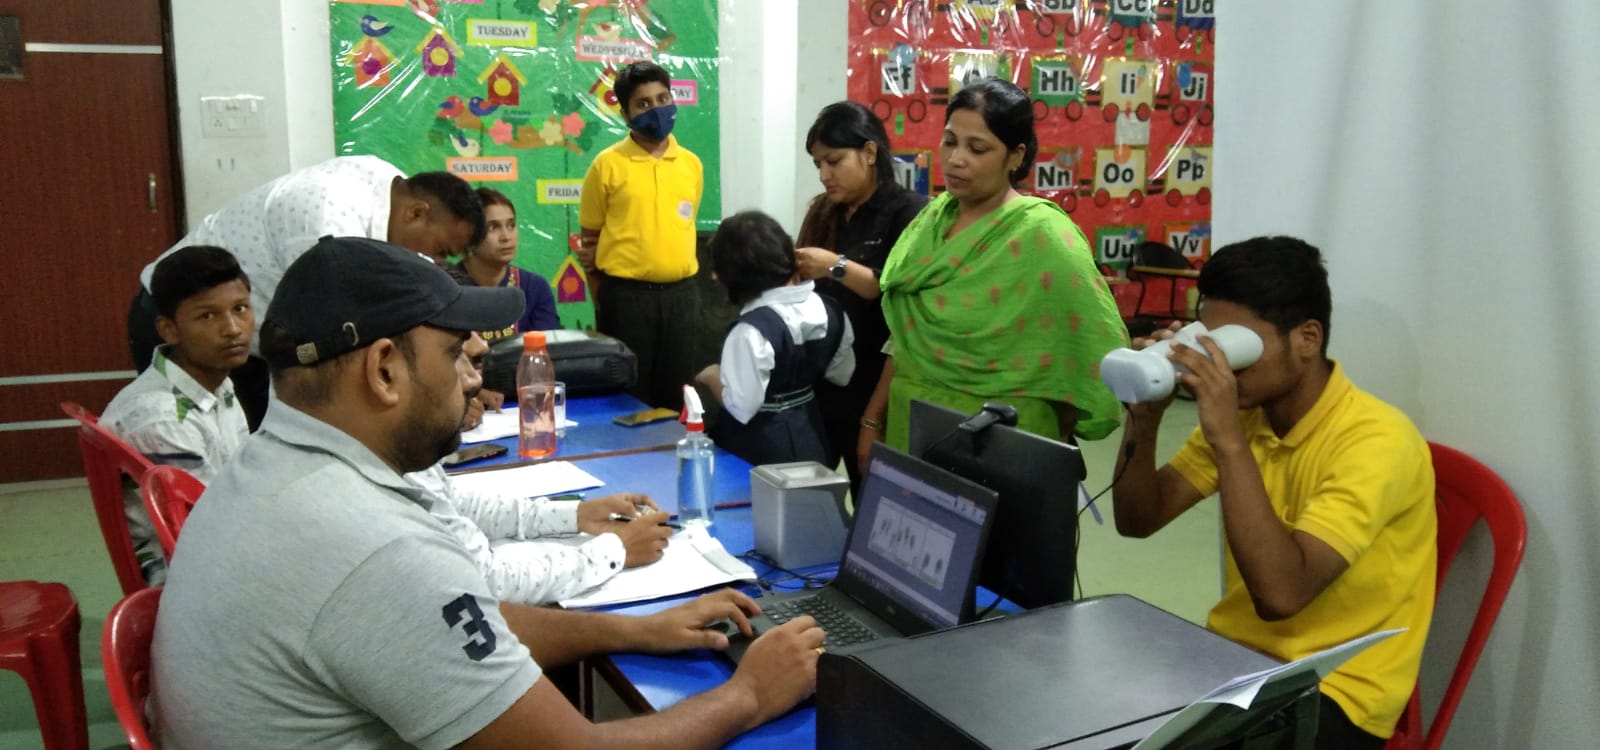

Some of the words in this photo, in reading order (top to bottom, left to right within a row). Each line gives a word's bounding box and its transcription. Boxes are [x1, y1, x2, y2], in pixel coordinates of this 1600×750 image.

[478, 25, 528, 38] TUESDAY
[1041, 70, 1074, 92] Hh
[452, 163, 512, 173] SATURDAY
[1037, 166, 1071, 187] Nn
[1103, 163, 1134, 183] Oo
[1176, 159, 1204, 181] Pp
[548, 187, 580, 197] FRIDA
[1104, 239, 1134, 259] Uu
[1172, 235, 1199, 253] Vv
[442, 592, 497, 661] 3
